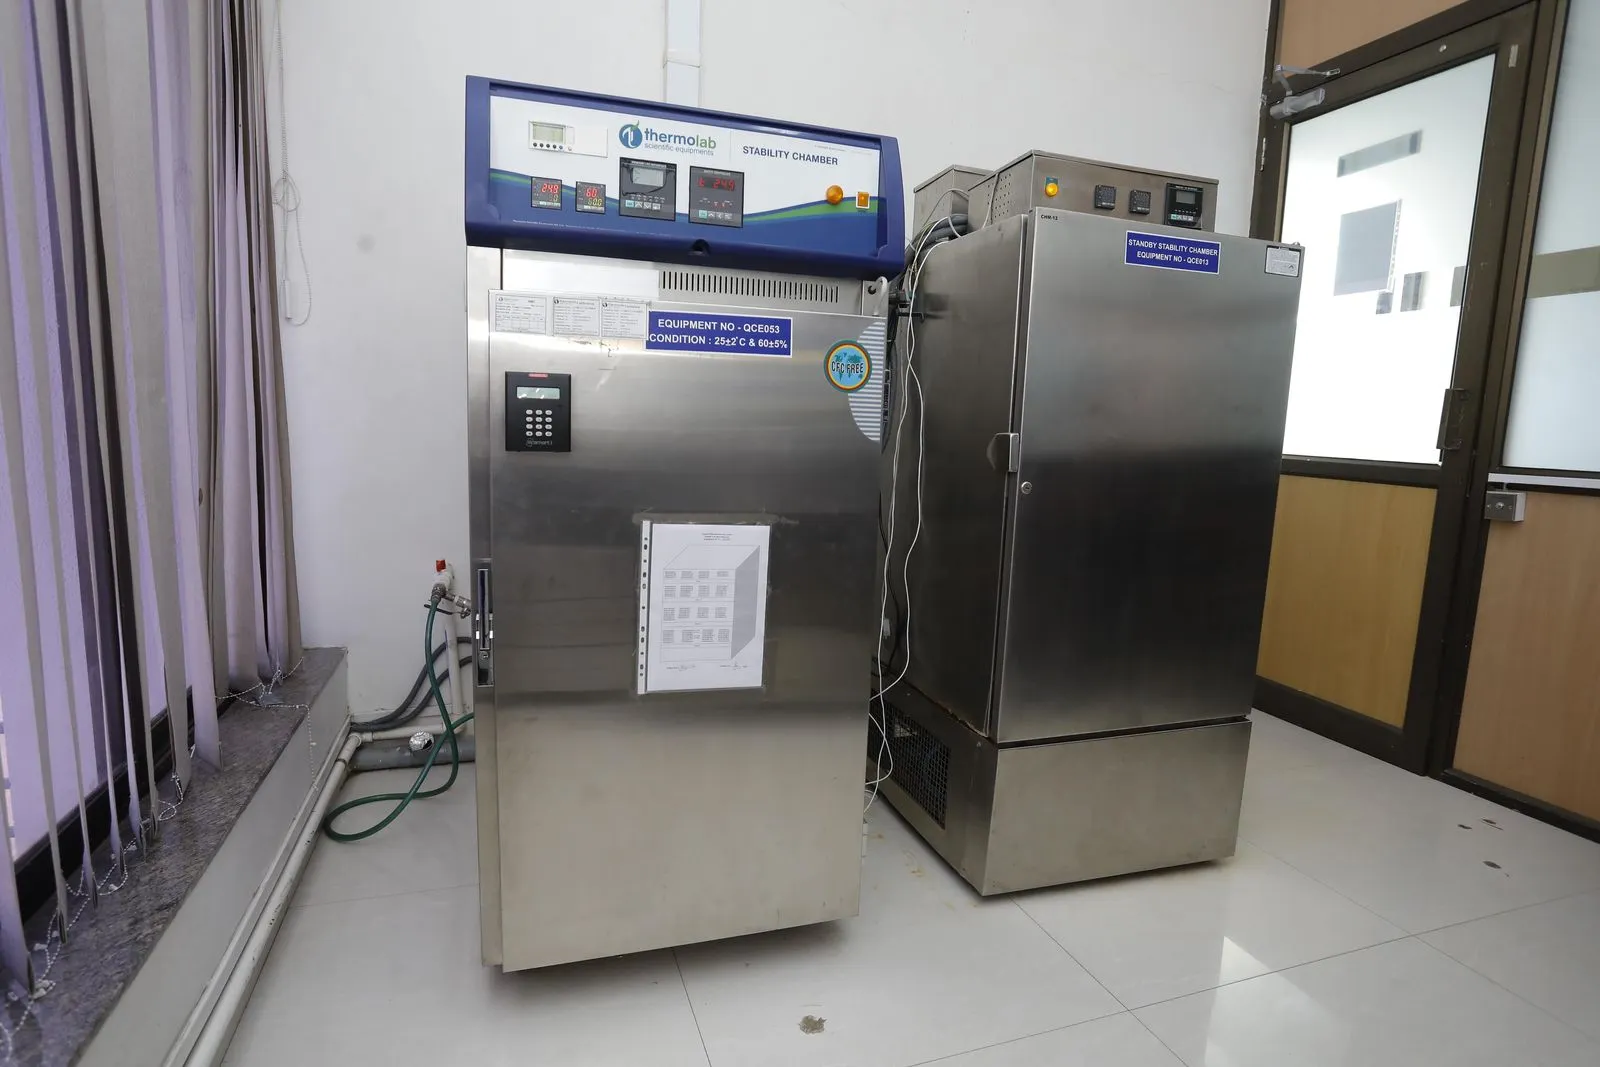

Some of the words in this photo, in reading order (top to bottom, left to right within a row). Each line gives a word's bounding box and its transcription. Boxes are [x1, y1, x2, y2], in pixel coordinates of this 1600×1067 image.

[644, 128, 716, 149] thermolab
[644, 143, 674, 152] scientific
[675, 146, 714, 156] equipments
[742, 145, 790, 160] STABILITY
[792, 152, 838, 165] CHAMBER
[1128, 239, 1157, 249] STANDBY
[1158, 242, 1188, 253] STABILITY
[1189, 246, 1218, 256] CHAMBER
[1136, 250, 1173, 262] EQUIPMENT
[1173, 255, 1183, 263] NO
[1187, 257, 1209, 266] QCE013
[658, 319, 717, 331] EQUIPMENT
[720, 322, 735, 331] NO
[743, 323, 780, 334] QCE053
[649, 333, 706, 345] CONDITION
[748, 339, 756, 347] &
[758, 339, 788, 349] 60±5%
[831, 361, 844, 374] CFC
[846, 362, 864, 374] FREE
